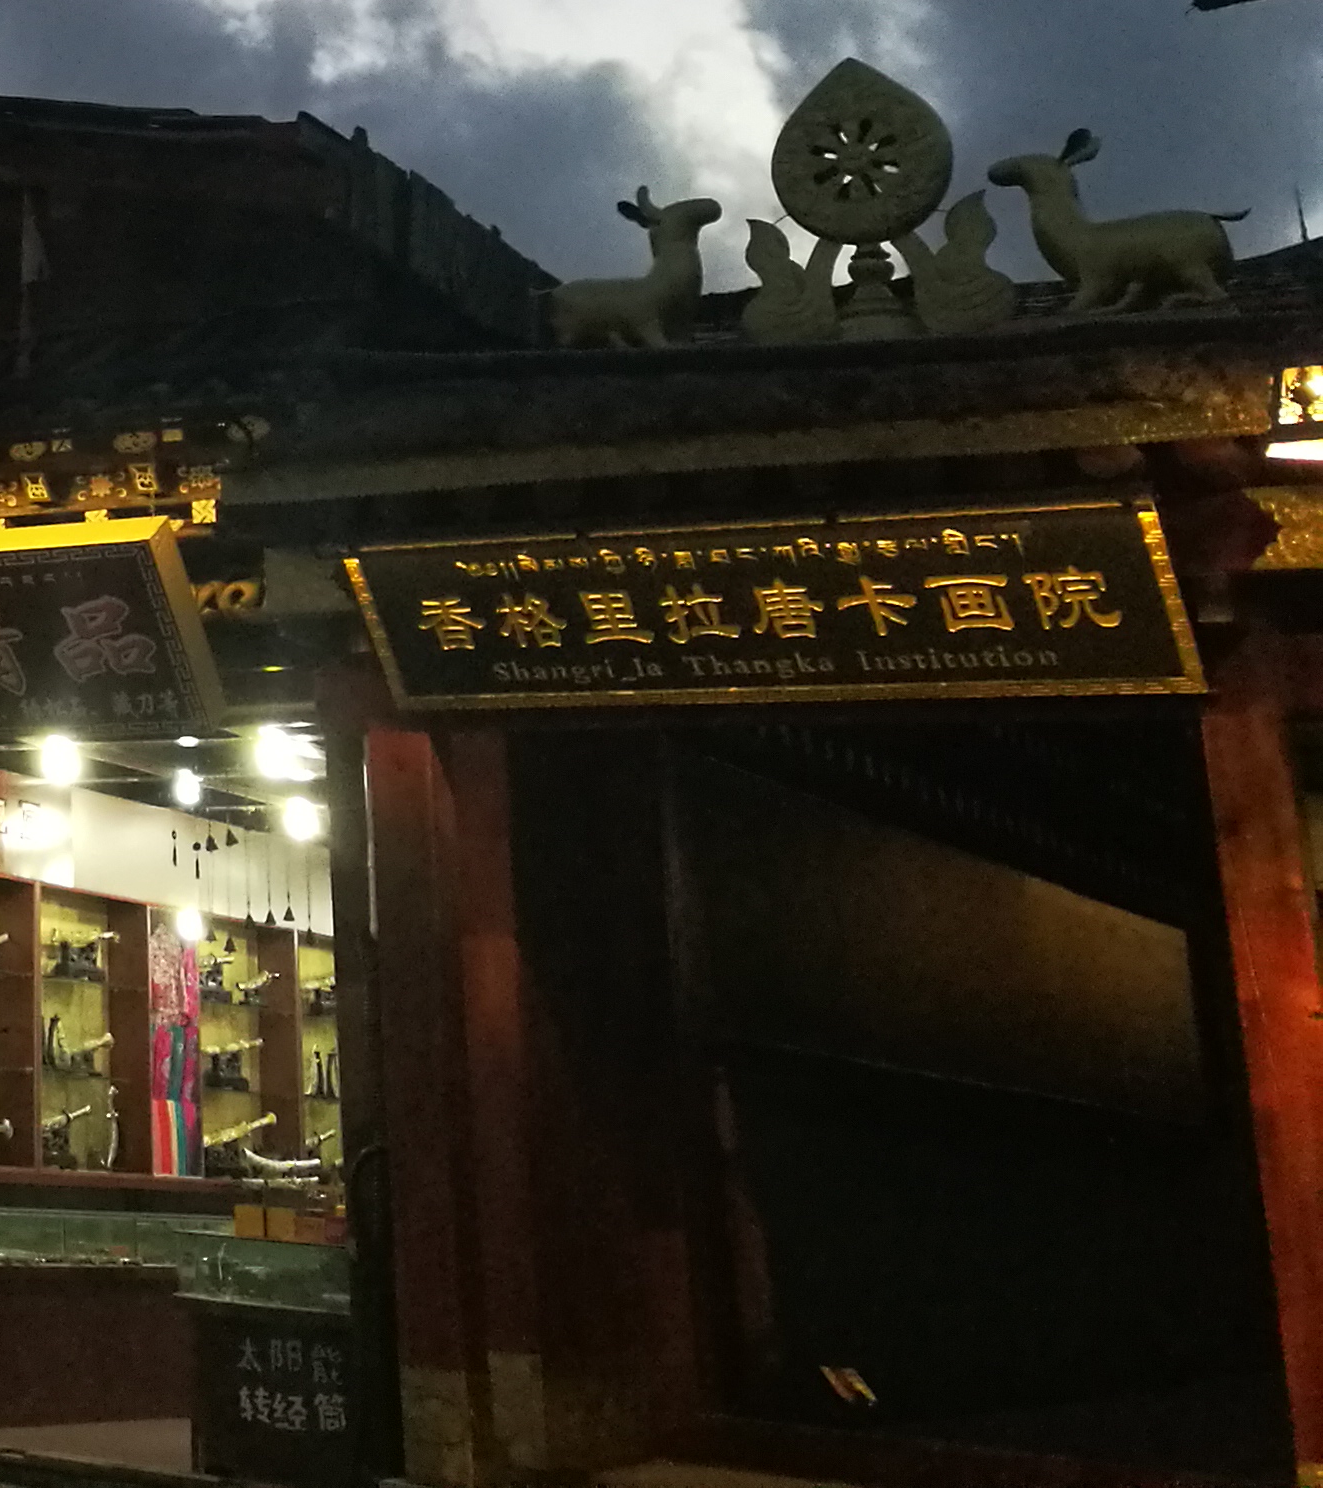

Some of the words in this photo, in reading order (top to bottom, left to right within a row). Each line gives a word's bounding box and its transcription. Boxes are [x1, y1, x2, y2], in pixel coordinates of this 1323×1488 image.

[417, 565, 1123, 651] 香格里拉唐卡画院
[681, 651, 835, 679] Thangka
[855, 645, 1060, 671] Institution
[239, 1385, 347, 1431] 转经筒
